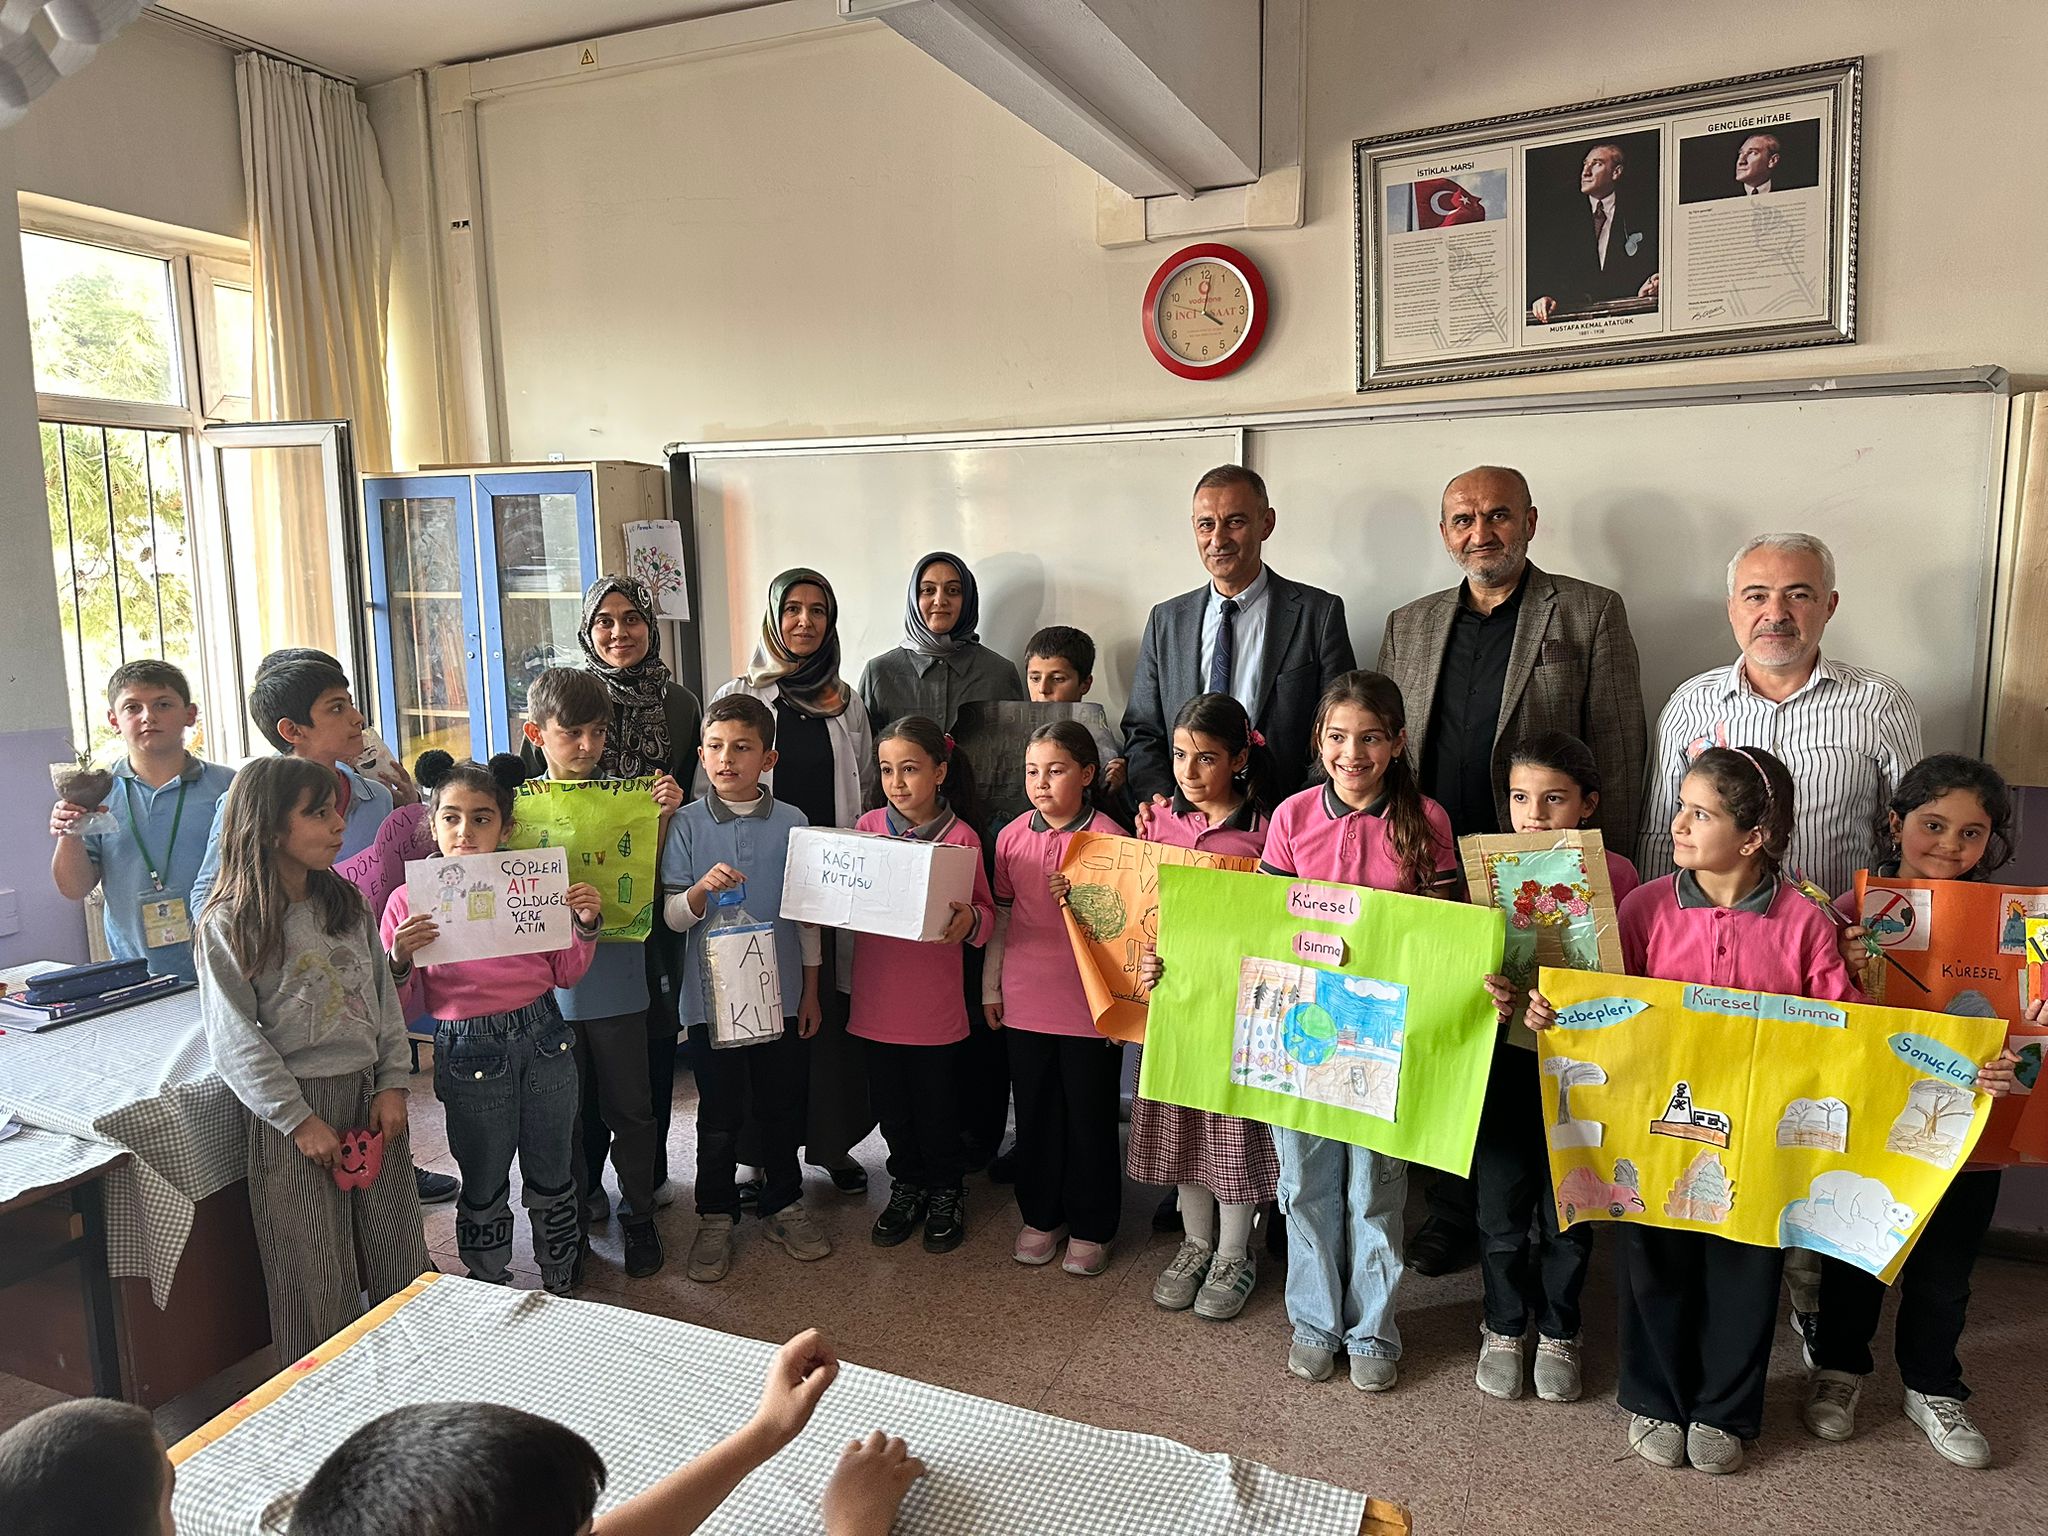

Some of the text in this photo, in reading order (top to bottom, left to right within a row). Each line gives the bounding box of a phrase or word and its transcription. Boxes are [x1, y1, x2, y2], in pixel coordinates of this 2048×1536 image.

[1707, 112, 1791, 132] GENÇLİĞE HİTABE
[1416, 165, 1450, 177] İSTİKLAL
[1200, 269, 1211, 280] 12
[1184, 277, 1192, 286] 11
[1171, 292, 1180, 303] 10
[1234, 288, 1241, 298] 2
[1189, 296, 1222, 305] vodaone
[1166, 311, 1172, 321] 9
[1239, 305, 1245, 315] 3
[1233, 325, 1239, 334] 4
[1549, 317, 1634, 333] MUSTAFA KEMAL ATATÜRK
[1171, 330, 1177, 339] 8
[1185, 343, 1190, 352] 7
[1219, 340, 1226, 349] 5
[1202, 346, 1208, 356] 6
[822, 848, 866, 873] KAĞIT
[501, 858, 562, 877] ÇÖPLERİ
[507, 876, 540, 895] AİT
[821, 870, 873, 890] KUTUSU
[1291, 891, 1354, 914] Küresel
[511, 910, 543, 924] YERE
[514, 922, 546, 935] ATIN
[1942, 960, 2002, 981] KÜRESEL
[1692, 986, 1760, 1012] Küresel
[1556, 999, 1634, 1026] Sebepleri
[459, 1221, 507, 1246] 1950
